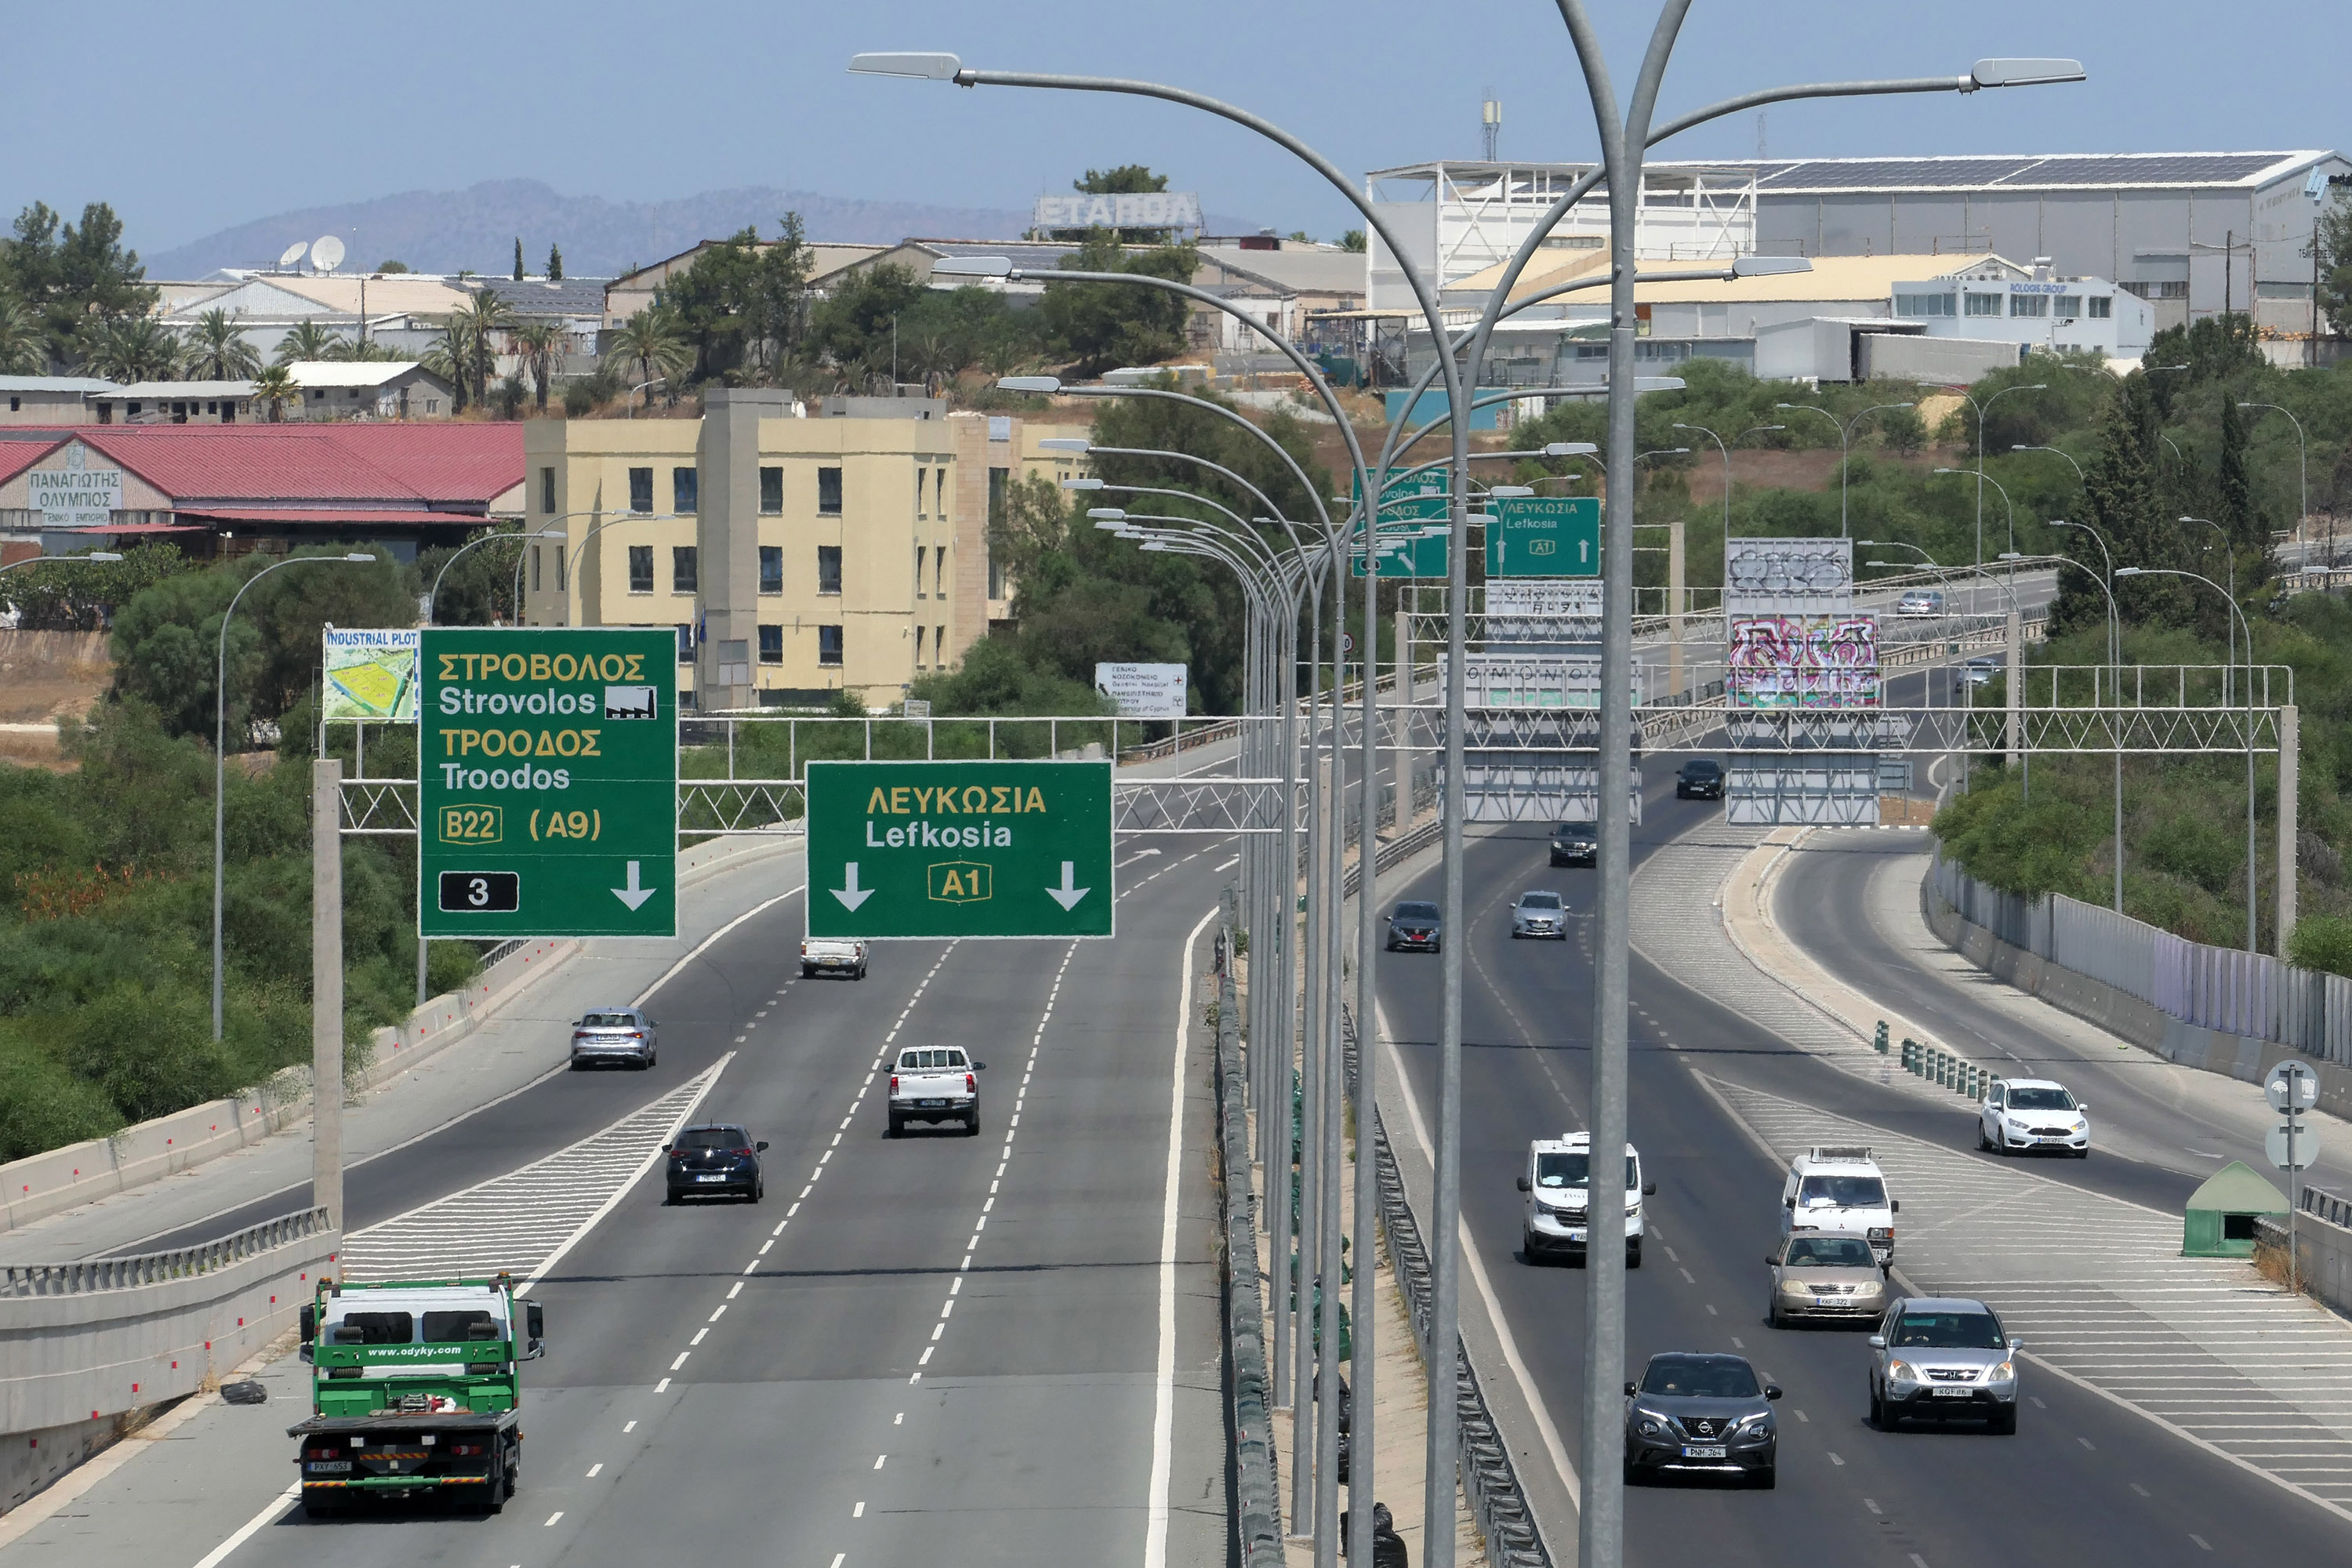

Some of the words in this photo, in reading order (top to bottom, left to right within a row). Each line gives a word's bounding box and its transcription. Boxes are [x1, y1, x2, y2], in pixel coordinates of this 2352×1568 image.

[2042, 284, 2067, 293] GROUP
[30, 473, 119, 488] ΠΑΝΑΓΙΩΤΗΣ
[39, 492, 111, 507] ΟΛΥΜΠΙΟΣ
[1507, 503, 1578, 514] ΛΕΥΚΩΣΙΑ
[42, 513, 69, 522] ΓΕΝΙΚΟ
[75, 513, 108, 522] ΕΜΠΟΡΙΟ
[1506, 518, 1558, 528] Lefkosia
[1535, 543, 1550, 553] A1
[327, 632, 388, 645] INDUSTRIAL
[438, 653, 645, 681] ΣΤΡΟΒΟΛΟΣ
[440, 687, 597, 715] Strovolos
[439, 729, 601, 757] ΤΡΟΟΔΟΣ
[439, 763, 570, 790] Troodos
[866, 786, 1046, 814] ΛΕΥΚΩΣΙΑ
[447, 811, 494, 837] B22
[530, 809, 601, 841] (A9)
[866, 820, 1011, 848] Lefkosia
[468, 878, 489, 906] 3
[942, 869, 979, 896] A1
[368, 1346, 461, 1357] www.odyky.com
